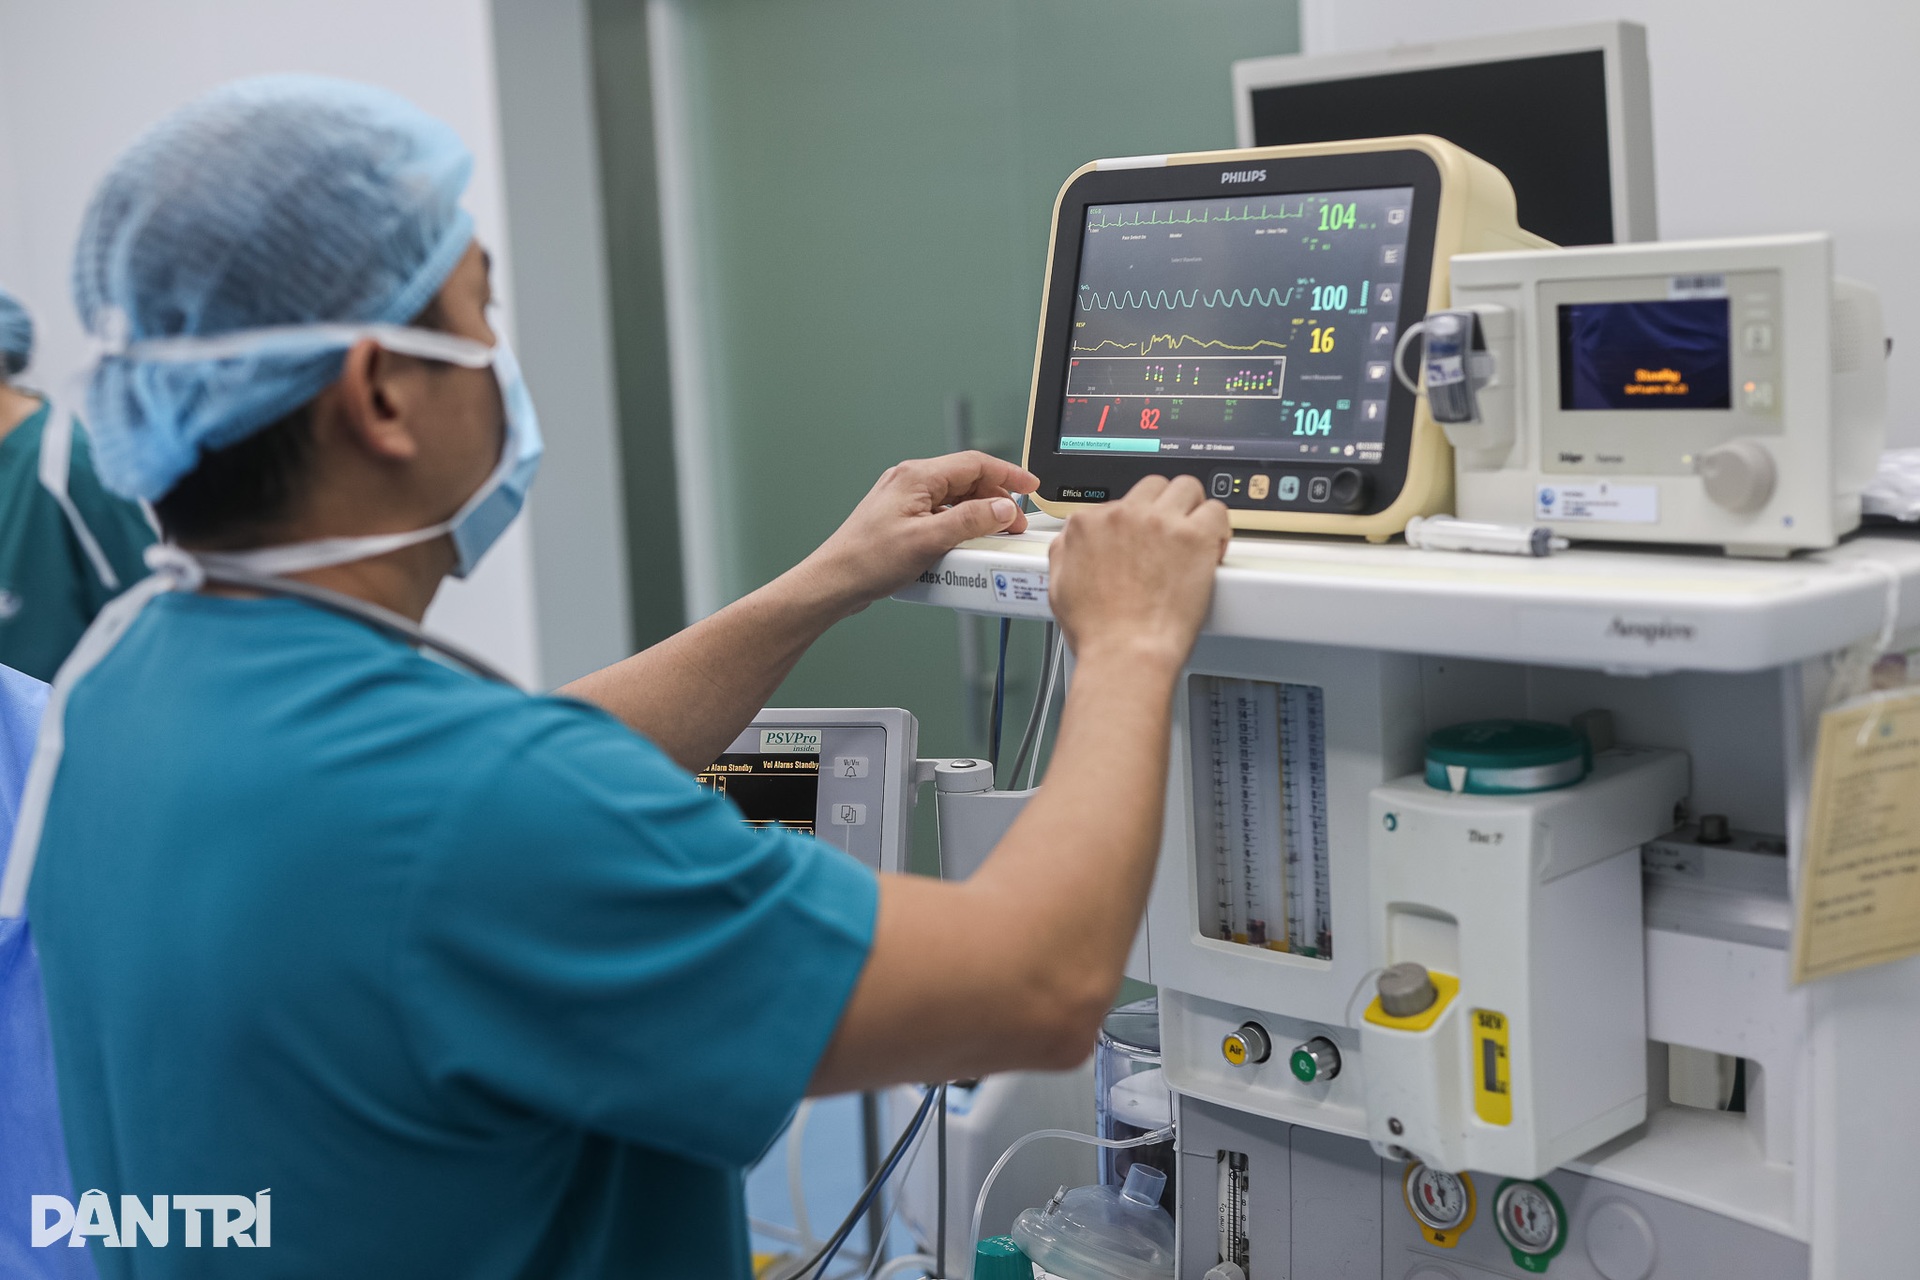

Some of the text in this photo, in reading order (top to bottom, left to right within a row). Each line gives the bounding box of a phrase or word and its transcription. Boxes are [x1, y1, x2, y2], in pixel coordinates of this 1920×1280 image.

[1221, 169, 1267, 184] PHILIPS
[1318, 202, 1357, 231] 104
[1310, 284, 1348, 311] 100
[1309, 326, 1335, 353] 16
[1140, 408, 1161, 430] 82
[1292, 408, 1332, 437] 104
[1086, 441, 1111, 449] Monitoring
[1062, 490, 1105, 499] Efficia CM120
[915, 569, 987, 589] atex-Ohmeda
[766, 732, 817, 744] PSVPro
[711, 763, 728, 771] Alarm
[728, 763, 753, 773] Standby
[763, 761, 819, 771] Vol Alarms Standby
[1229, 1044, 1243, 1056] Air
